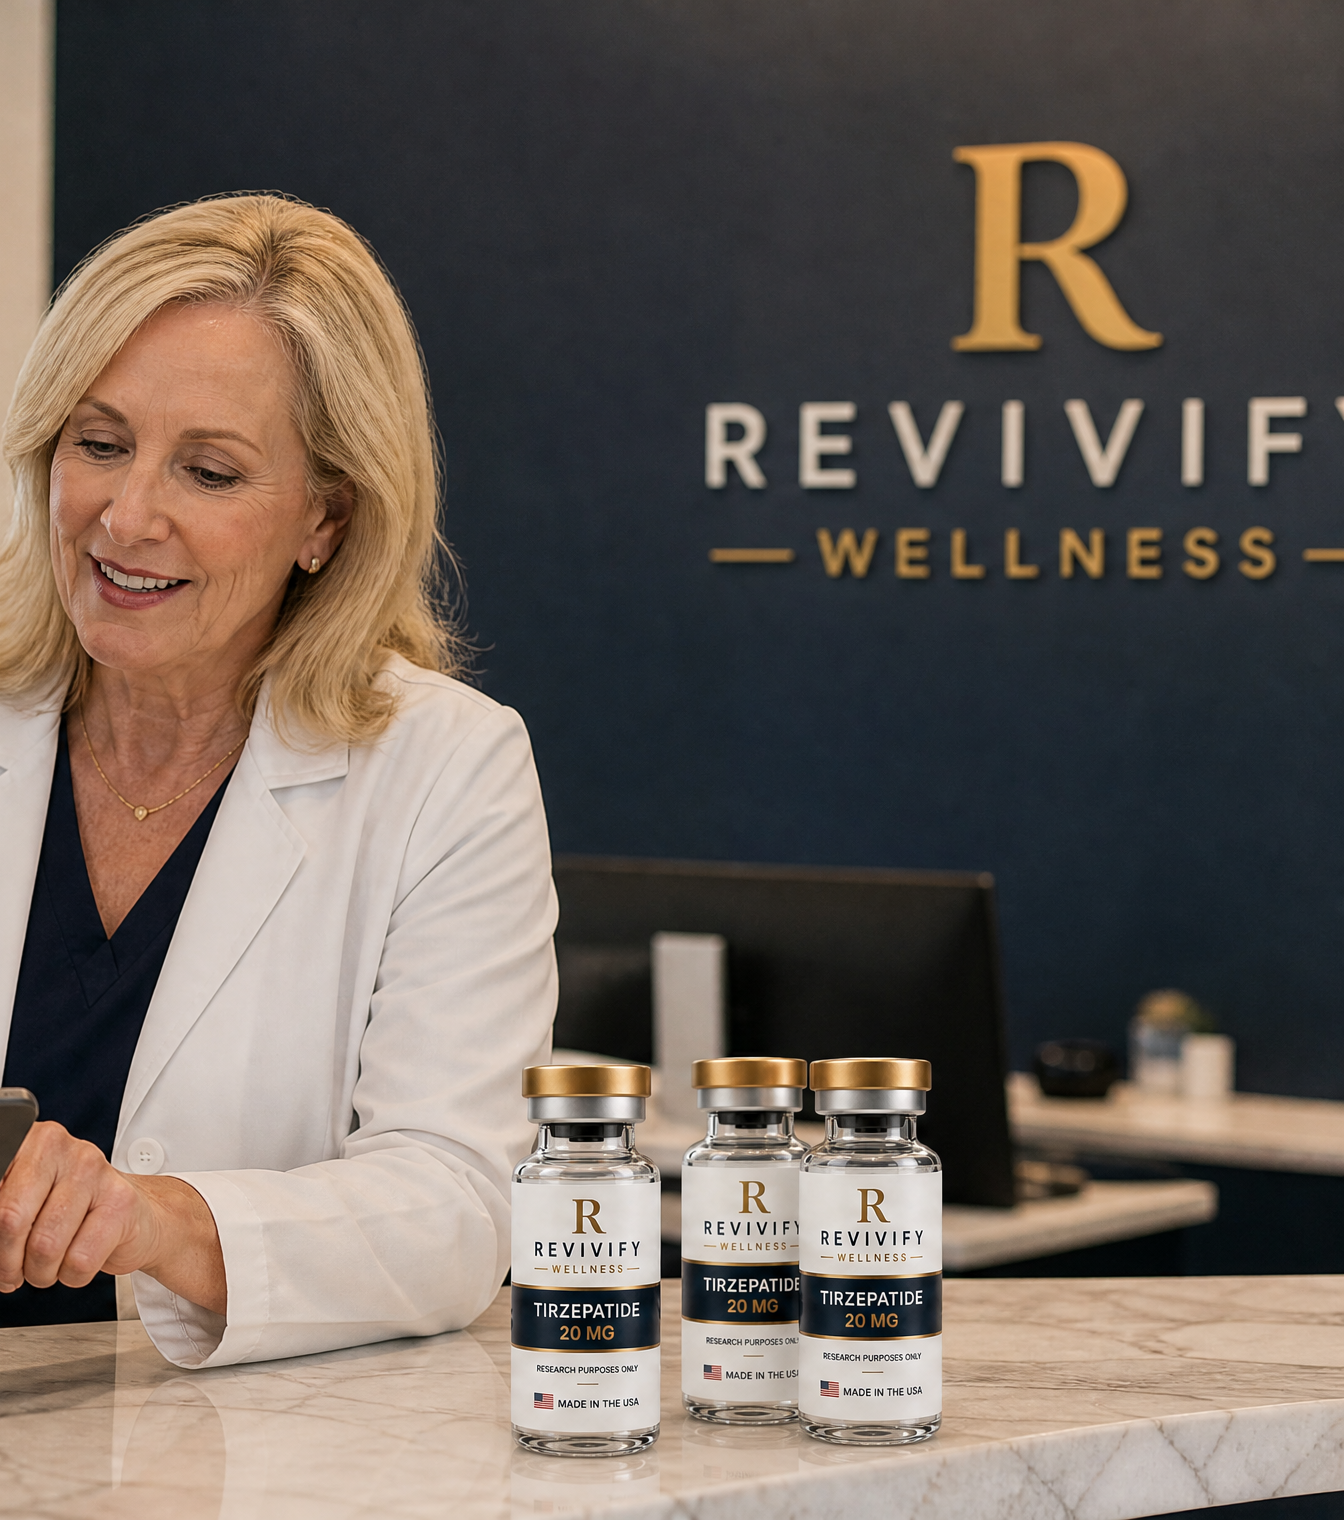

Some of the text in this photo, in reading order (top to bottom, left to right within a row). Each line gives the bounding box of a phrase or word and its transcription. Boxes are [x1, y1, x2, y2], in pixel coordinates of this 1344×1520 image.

[951, 140, 1165, 352] R
[704, 395, 1344, 489] REVIVIF
[815, 526, 1278, 580] WELLNESS
[739, 1180, 771, 1214] R
[857, 1188, 891, 1223] R
[572, 1198, 607, 1234] R
[820, 1230, 924, 1246] REVIVIFY
[534, 1241, 640, 1258] REVIVIFY
[720, 1242, 787, 1251] WELLNESS
[837, 1253, 907, 1263] WELLNESS
[552, 1264, 623, 1274] WELLNESS
[703, 1277, 799, 1293] TIRZEPATIDE
[727, 1299, 779, 1313] 20 MG
[820, 1290, 923, 1307] TIRZEPATIDE
[533, 1302, 640, 1319] TIRZEPATIDE
[845, 1313, 899, 1328] 20 MG
[559, 1325, 615, 1341] 20 MG
[705, 1336, 742, 1346] RESEARCH
[744, 1337, 783, 1346] PURPOSES
[823, 1352, 922, 1362] RESEARCH PURPOSES ONLY
[536, 1364, 639, 1374] RESEARCH PURPOSES ONLY
[725, 1371, 753, 1380] MADE
[755, 1371, 765, 1380] IN
[767, 1370, 785, 1379] THE
[843, 1386, 923, 1397] MADE IN THE USA
[557, 1397, 640, 1409] MADE IN THE USA
